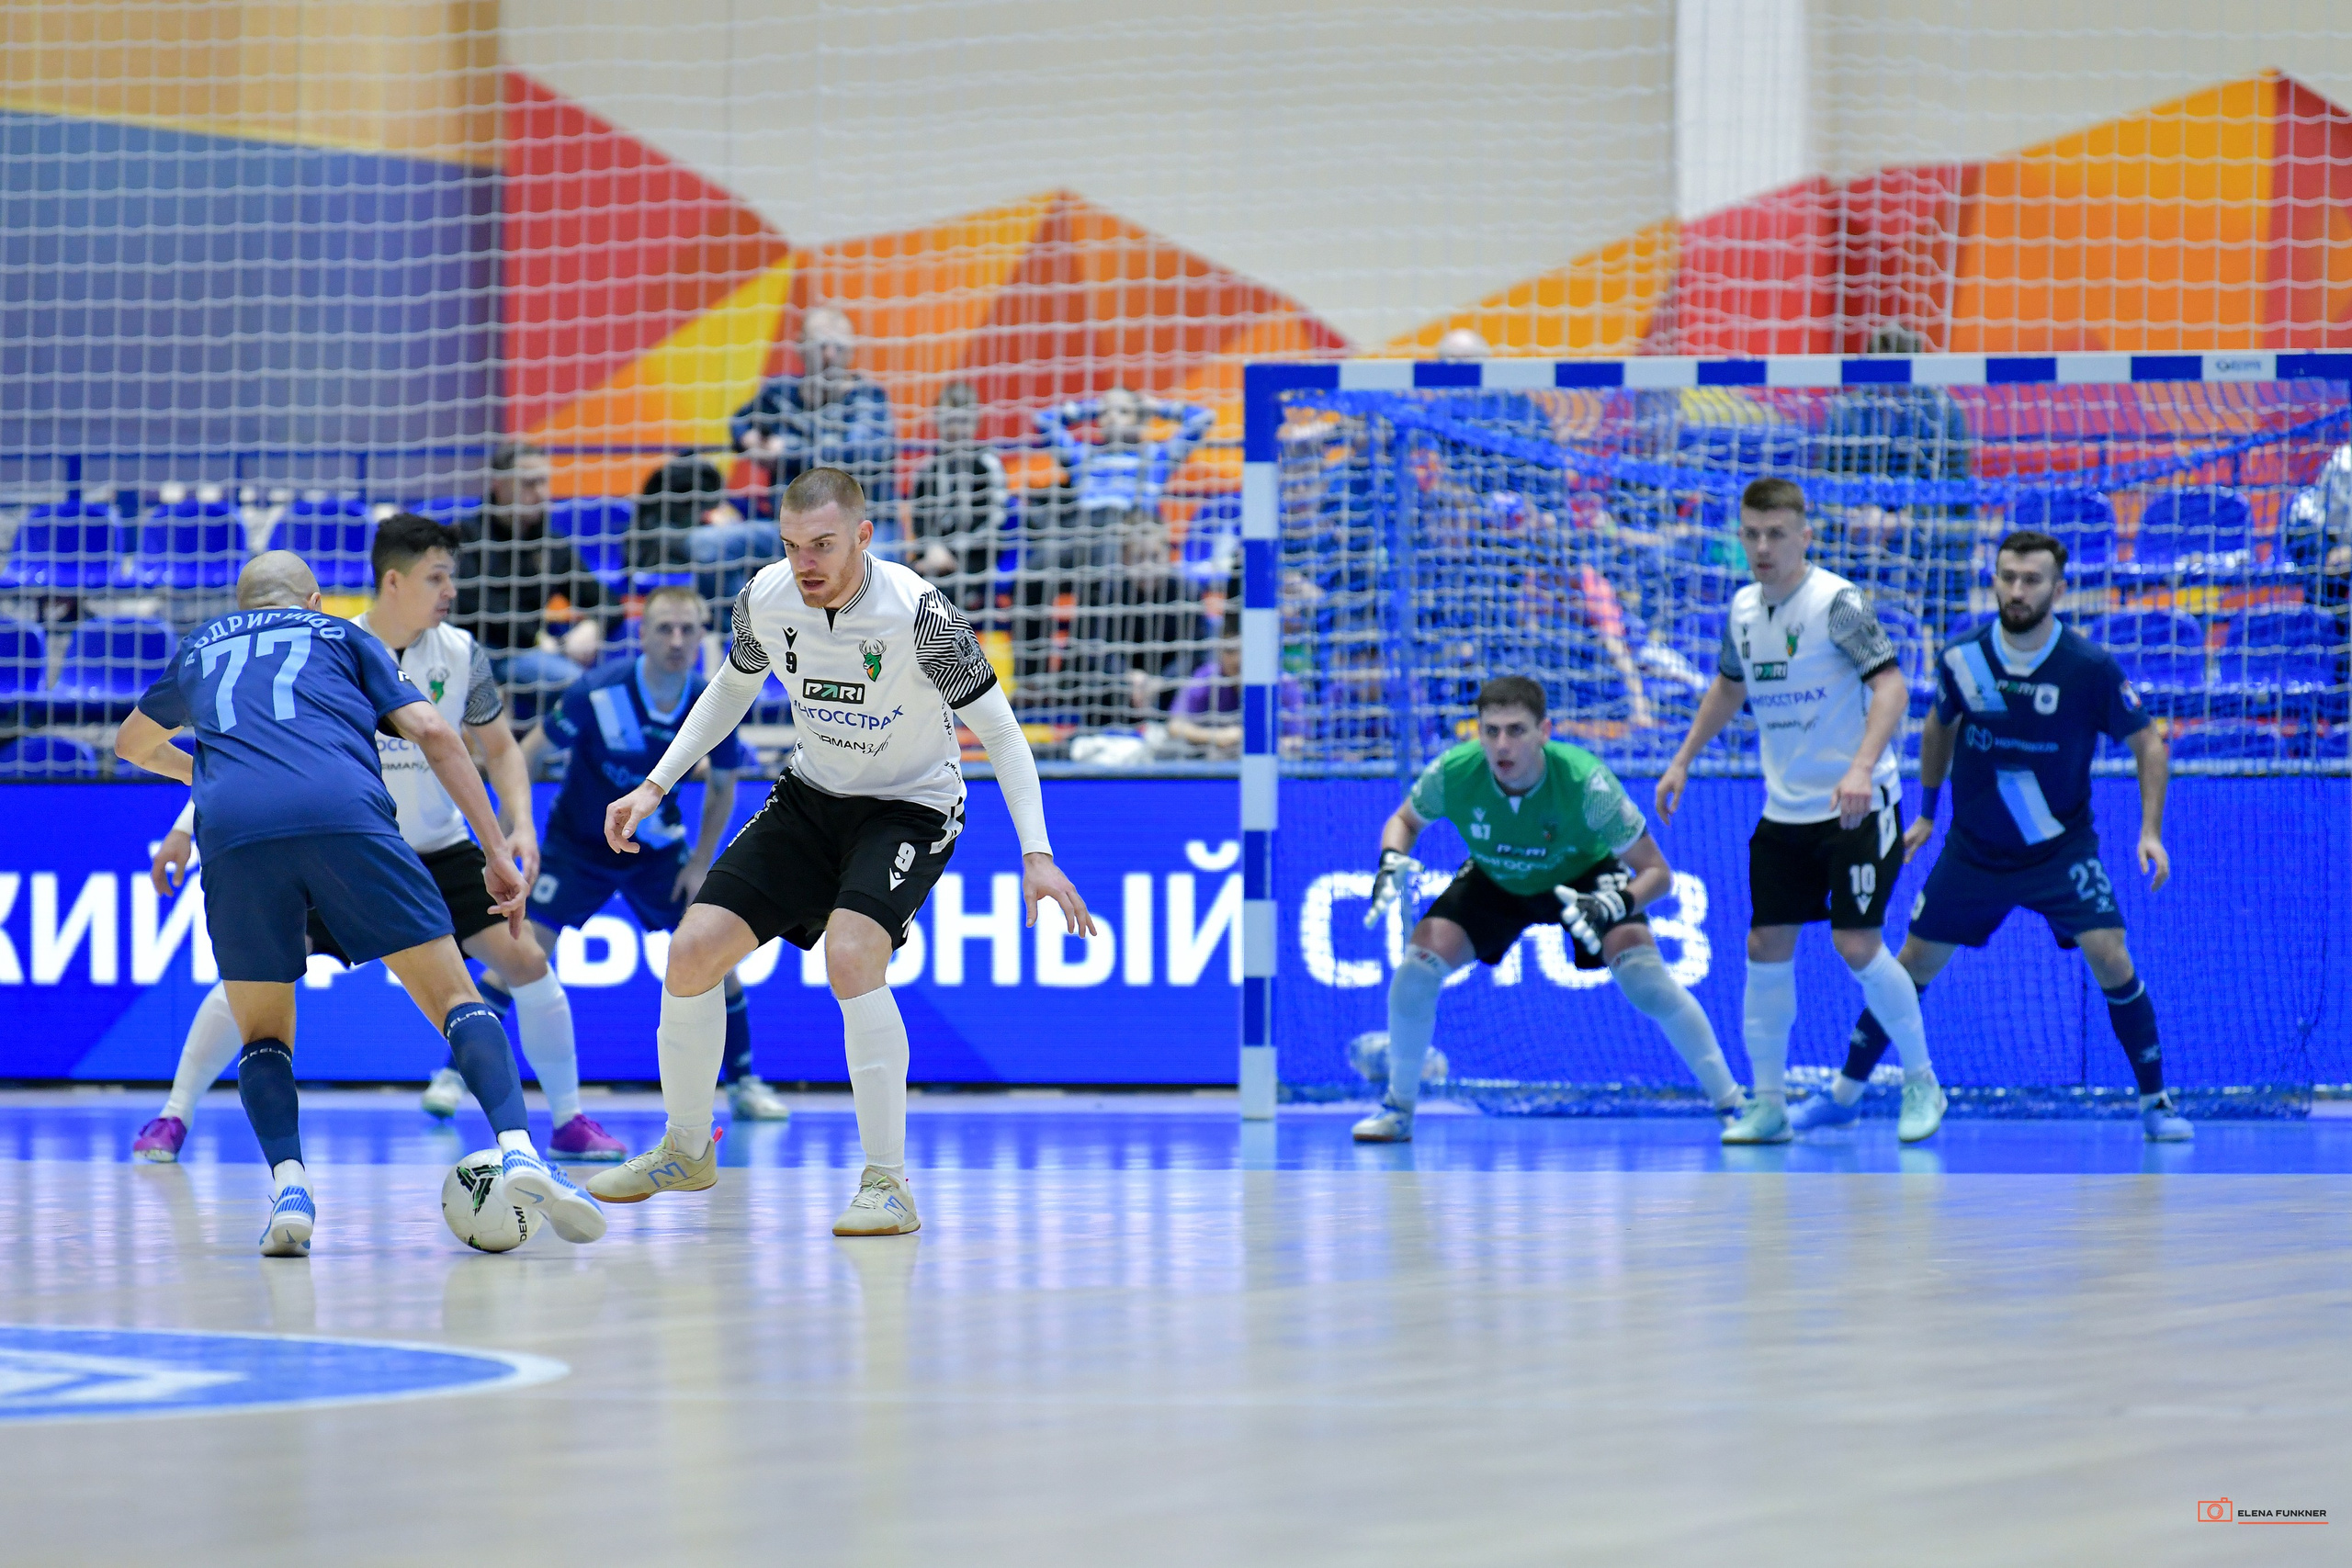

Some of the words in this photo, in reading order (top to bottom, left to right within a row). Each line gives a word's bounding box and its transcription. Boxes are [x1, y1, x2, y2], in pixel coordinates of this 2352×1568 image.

[786, 651, 797, 674] 9
[200, 627, 312, 733] 77
[805, 682, 864, 701] PARI
[894, 841, 916, 873] 9
[1849, 863, 1876, 897] 10
[2069, 857, 2112, 901] 23
